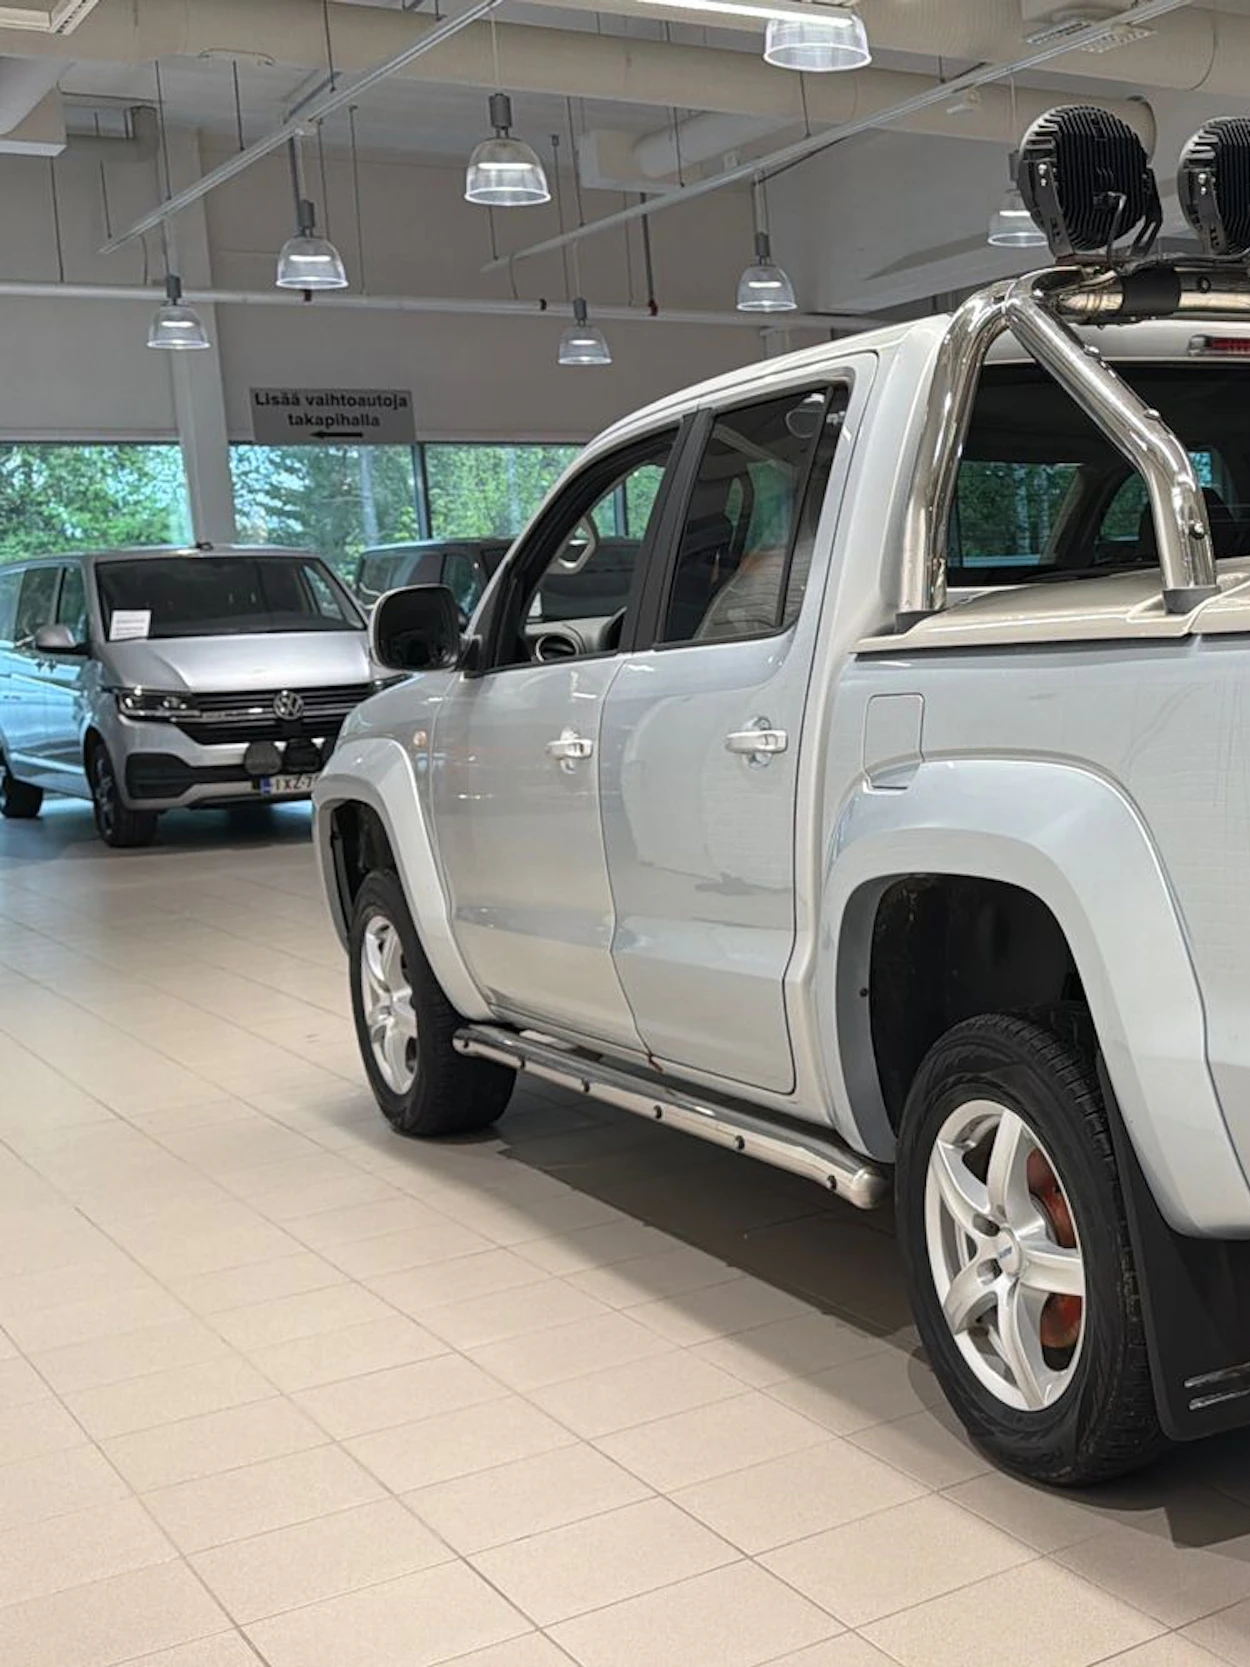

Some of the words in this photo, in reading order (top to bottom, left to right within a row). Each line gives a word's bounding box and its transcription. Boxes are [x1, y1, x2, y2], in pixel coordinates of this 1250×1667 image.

[254, 392, 301, 406] Lisää
[305, 393, 408, 411] vaihtoautoja
[287, 413, 381, 429] takapihalla
